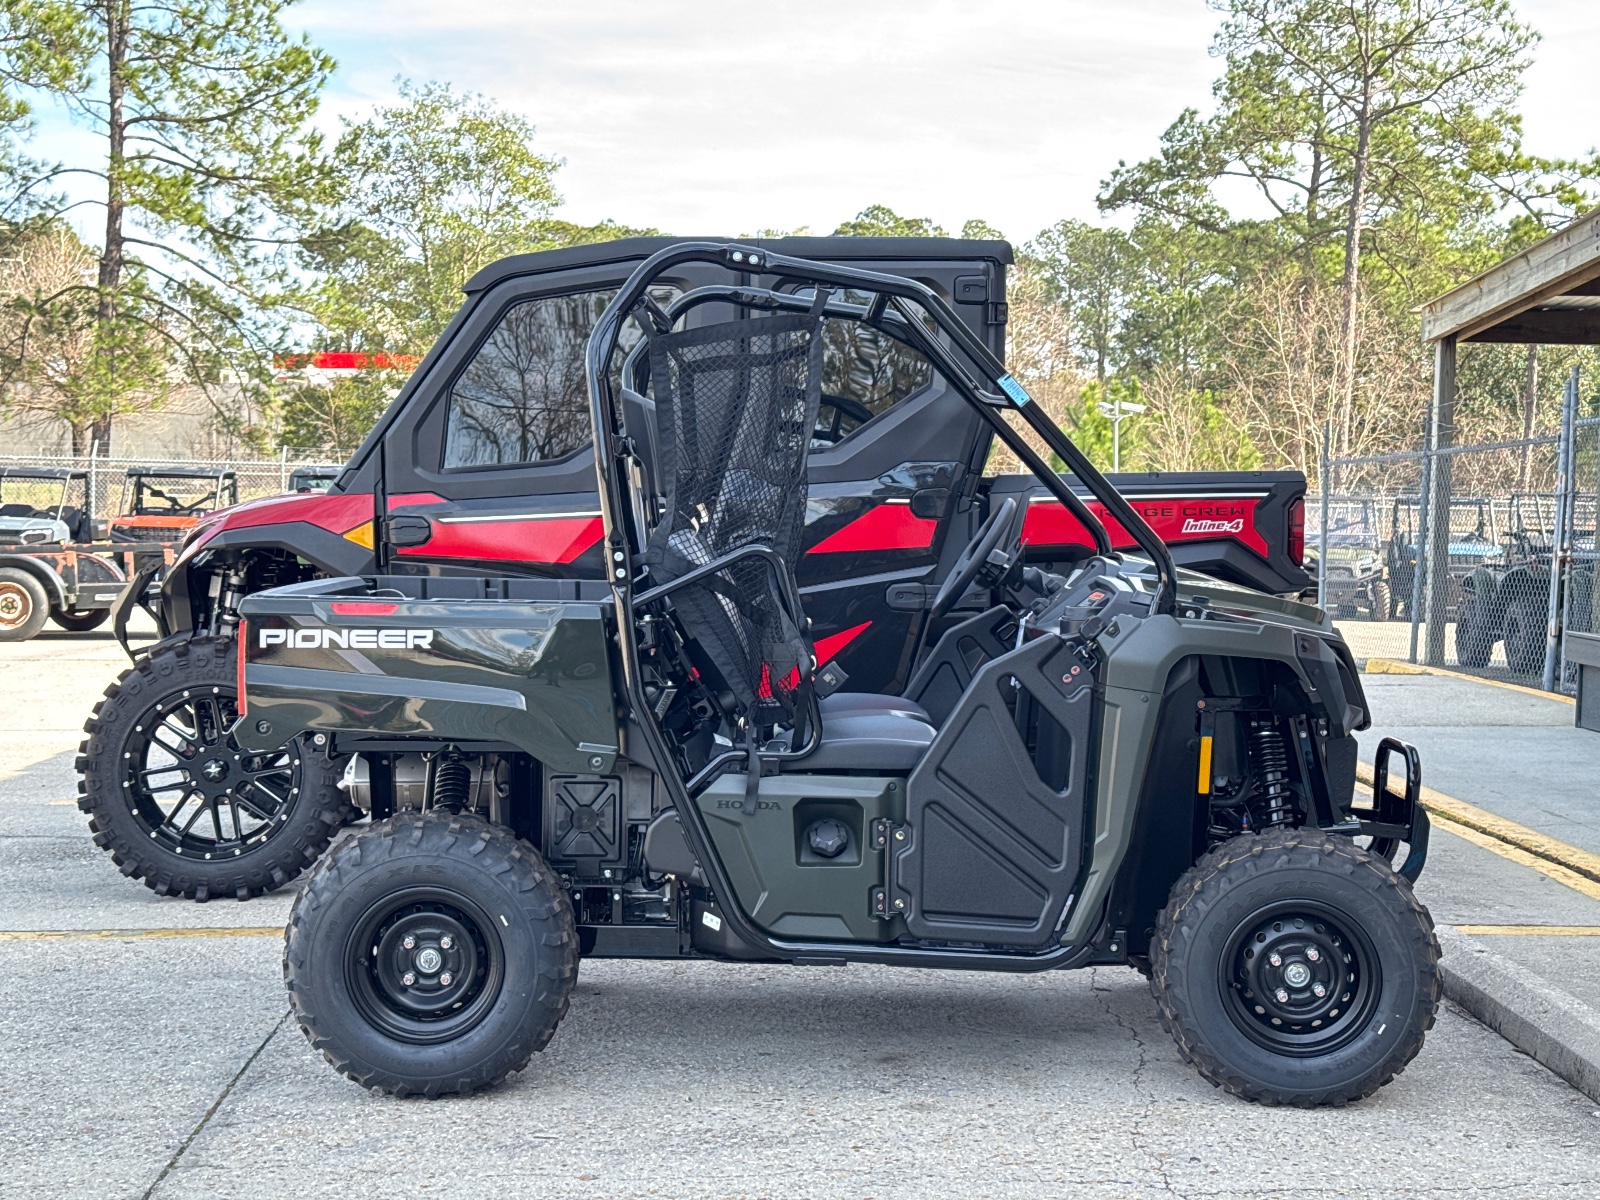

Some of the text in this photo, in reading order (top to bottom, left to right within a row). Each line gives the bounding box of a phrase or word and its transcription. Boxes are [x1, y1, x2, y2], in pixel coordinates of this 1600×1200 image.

[1100, 506, 1245, 517] RGE CREW
[1182, 519, 1243, 532] Inline-4
[258, 628, 434, 649] PIONEER
[717, 801, 783, 810] HODA
[324, 863, 447, 938] MAXXIS
